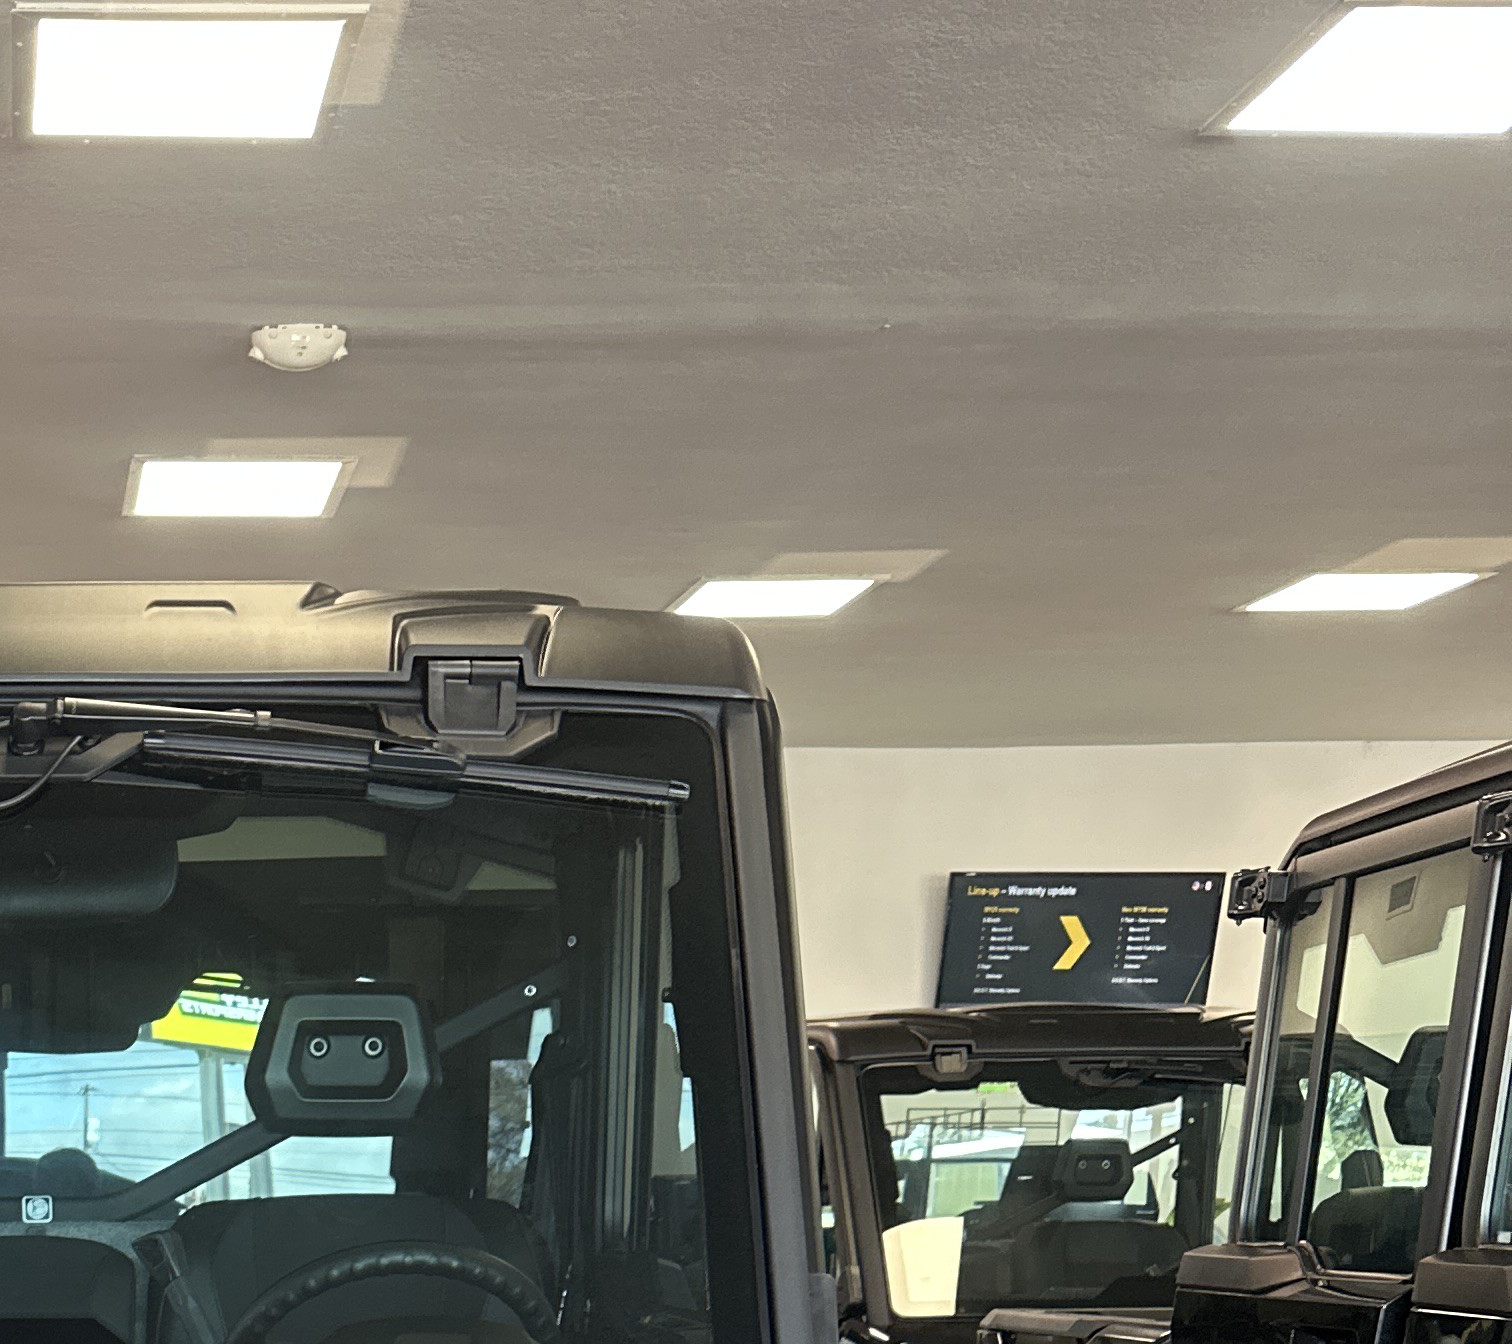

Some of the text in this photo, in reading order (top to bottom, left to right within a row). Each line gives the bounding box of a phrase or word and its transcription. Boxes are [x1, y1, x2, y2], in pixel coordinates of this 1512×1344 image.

[967, 886, 1000, 897] Line-up
[1008, 885, 1046, 898] Warranty
[1047, 885, 1077, 898] update
